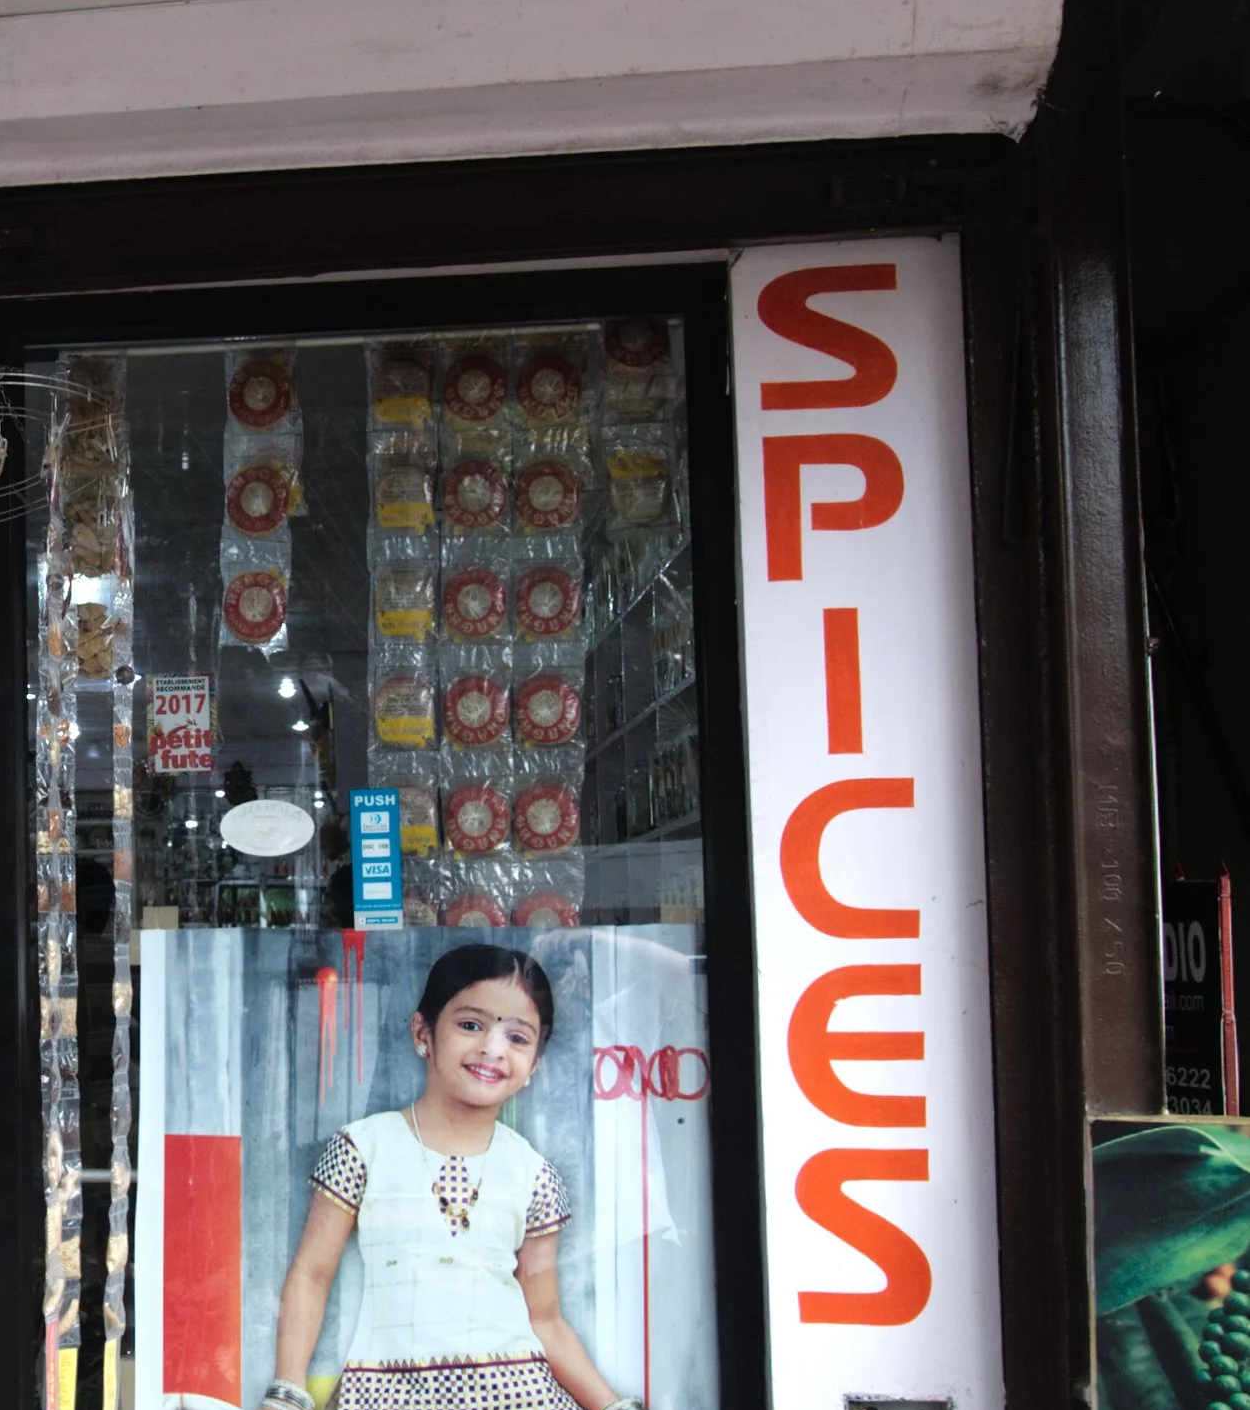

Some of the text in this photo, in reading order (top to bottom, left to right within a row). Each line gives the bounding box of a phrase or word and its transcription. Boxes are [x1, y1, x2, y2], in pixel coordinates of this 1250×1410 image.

[155, 693, 206, 715] 2017
[150, 728, 214, 756] petit
[354, 794, 396, 806] PUSH
[757, 263, 932, 1327] SPICES
[364, 864, 390, 874] VISA
